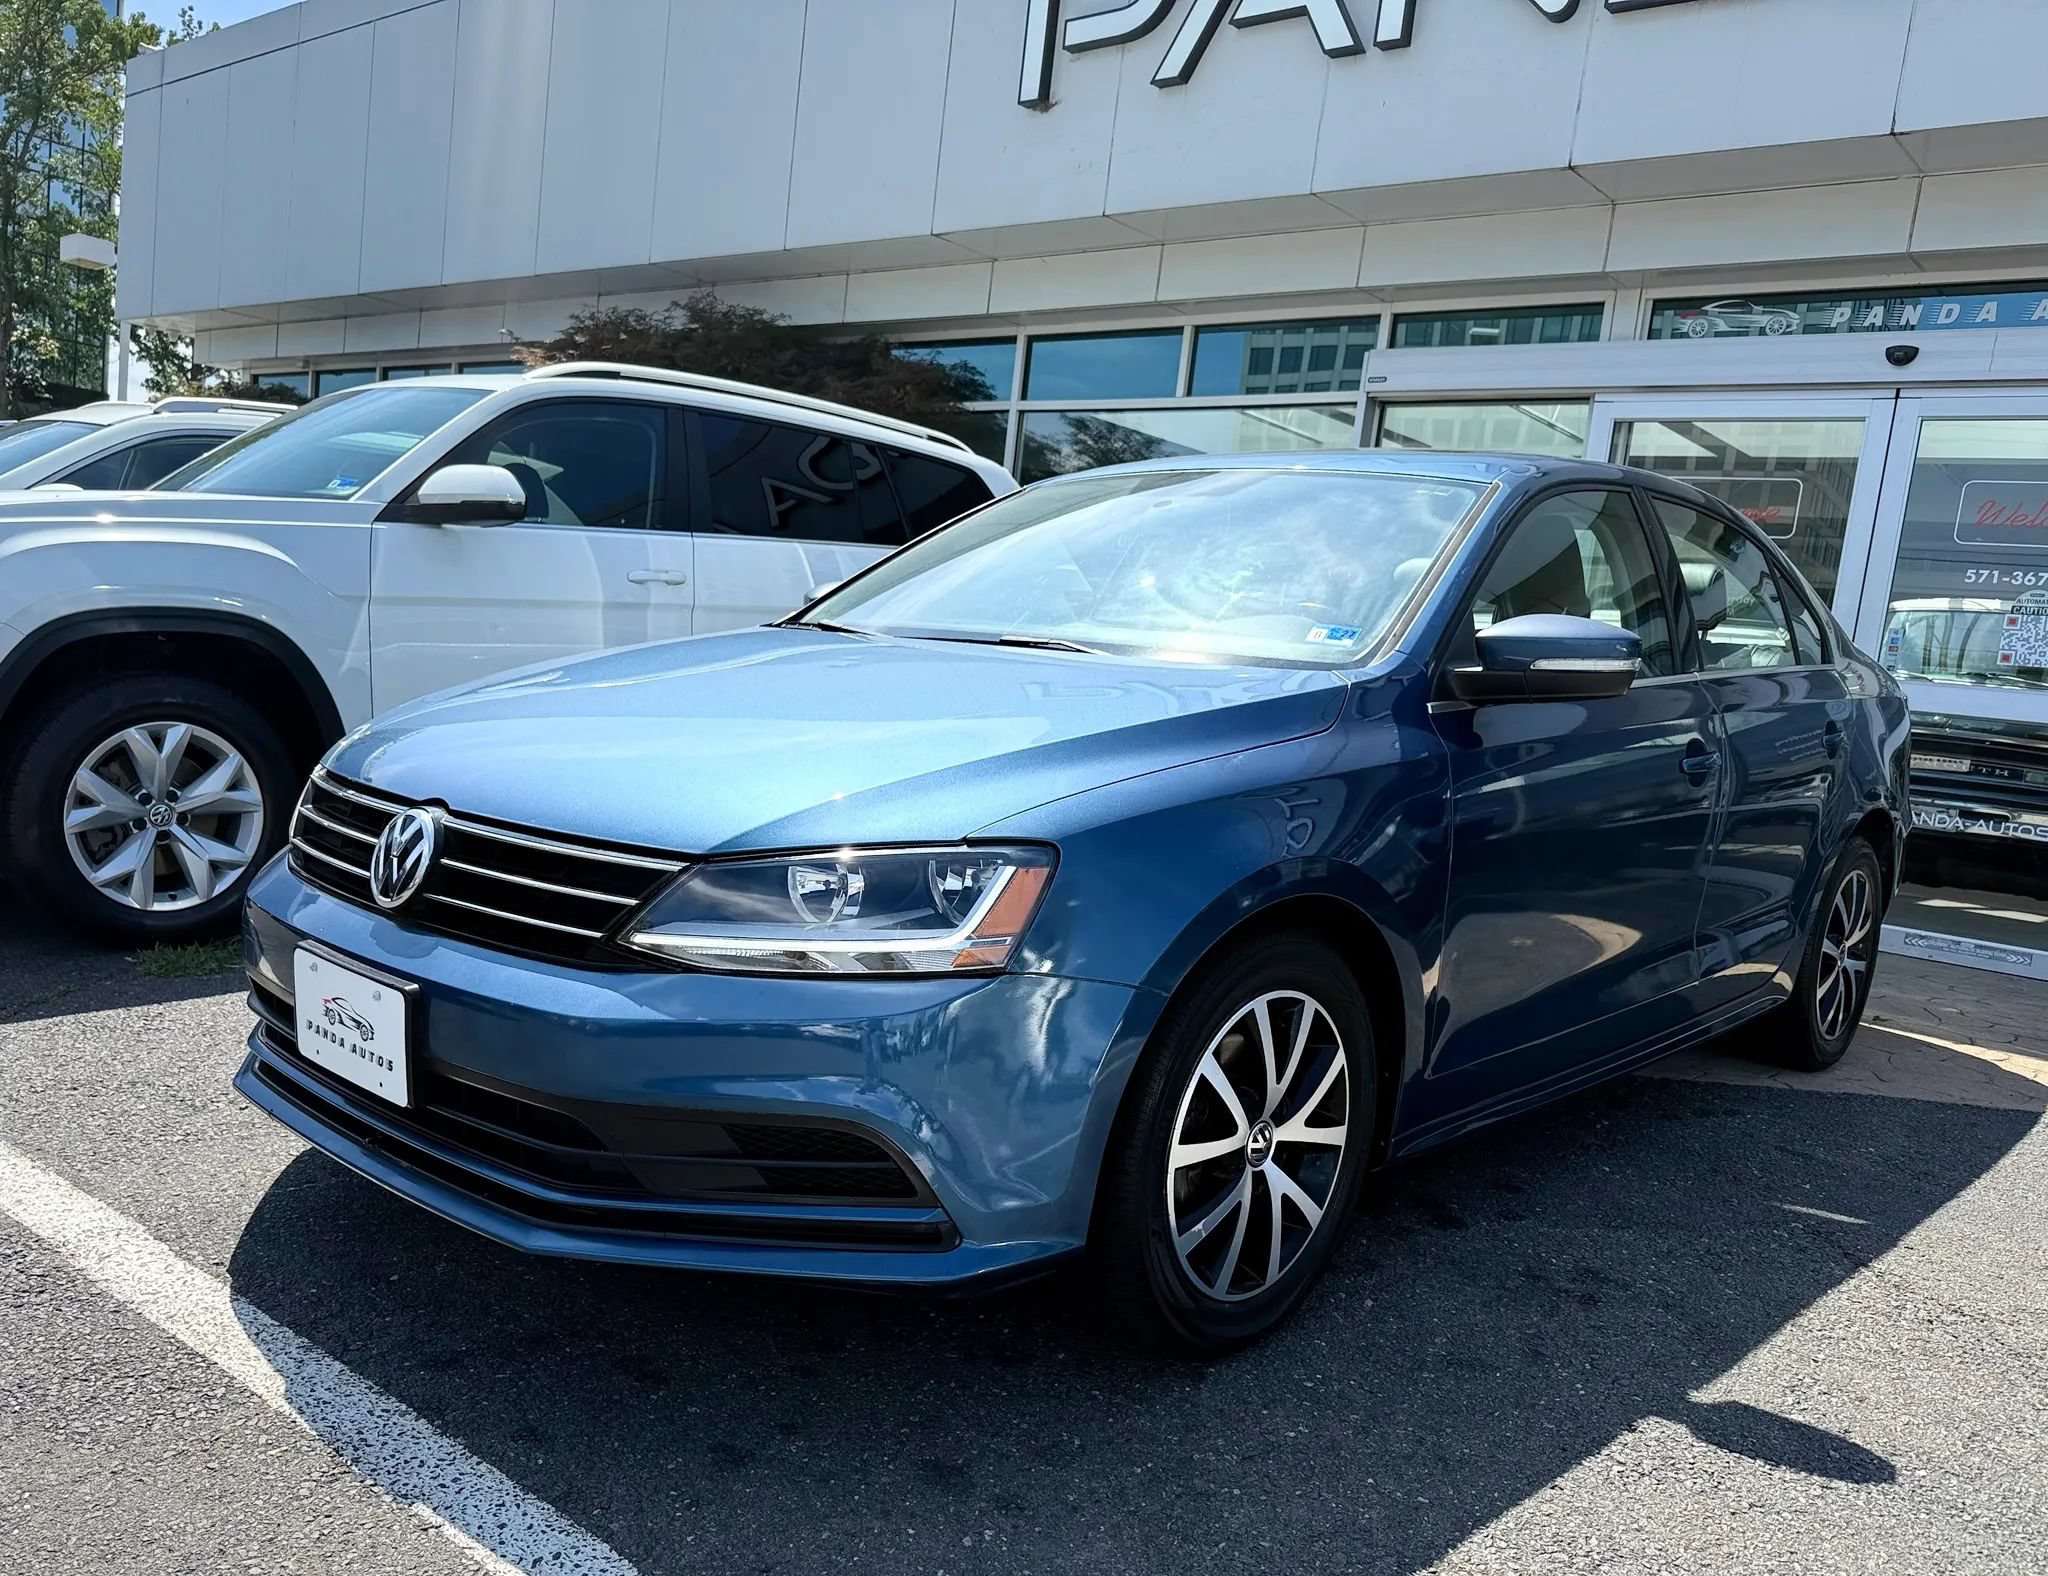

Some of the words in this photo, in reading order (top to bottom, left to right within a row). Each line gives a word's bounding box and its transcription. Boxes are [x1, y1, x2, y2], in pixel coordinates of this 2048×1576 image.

[1824, 301, 1998, 328] PANDA
[1964, 569, 2048, 586] 571-367
[1911, 810, 2048, 841] ANDA-AUTOS
[305, 1018, 345, 1048] PANDA
[350, 1042, 394, 1072] AUTOS
